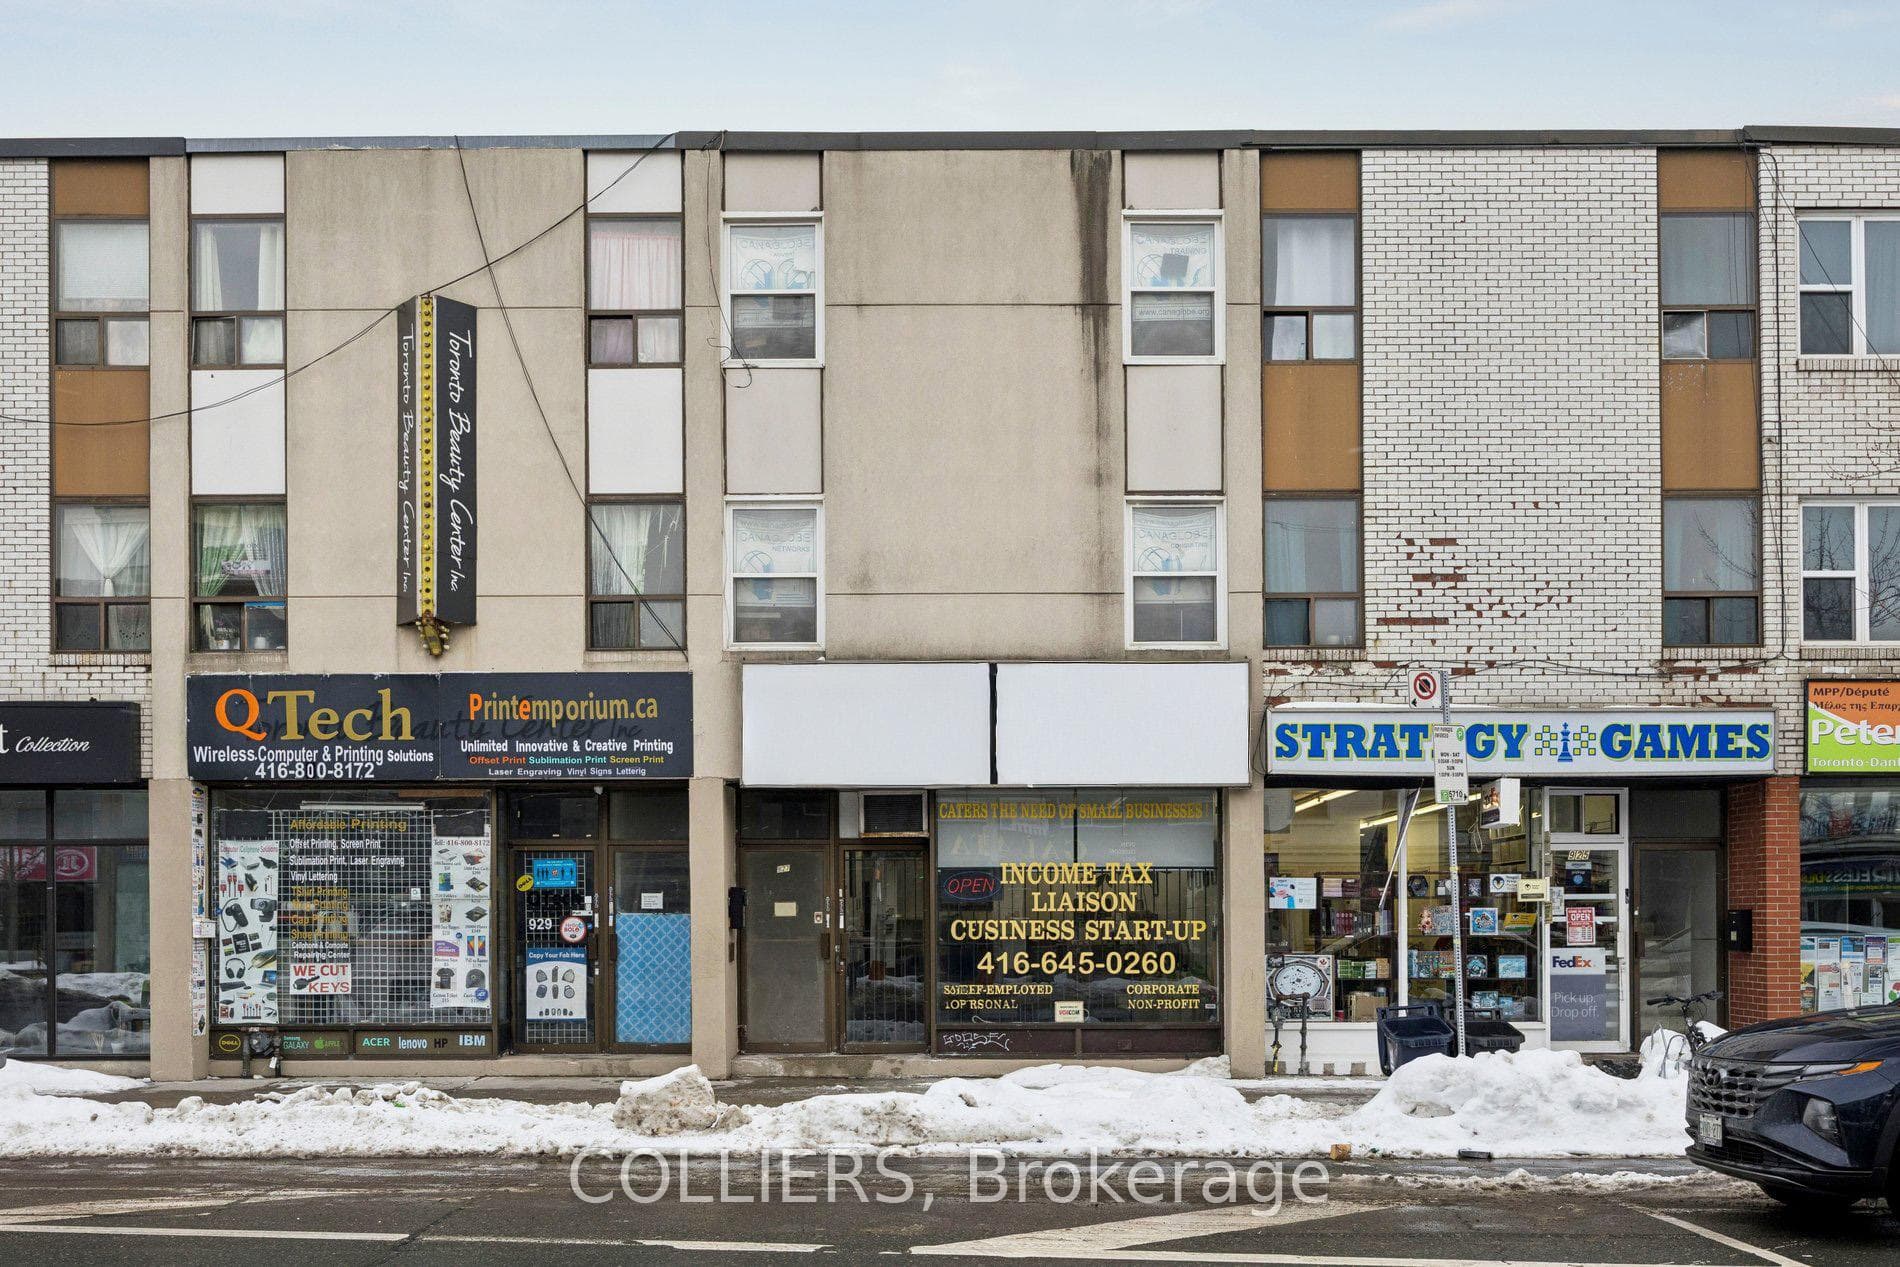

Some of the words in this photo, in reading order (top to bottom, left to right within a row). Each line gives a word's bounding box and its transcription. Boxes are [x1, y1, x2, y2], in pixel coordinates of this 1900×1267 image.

[402, 323, 415, 404] Toronto
[449, 330, 472, 404] Toronto
[399, 409, 414, 495] Beauty
[439, 408, 471, 493] Beauty
[403, 501, 415, 565] Center
[450, 499, 474, 570] Center
[1813, 687, 1890, 698] MPP/Député
[469, 691, 659, 728] Printemporium.ca
[16, 736, 90, 753] Collection
[461, 740, 508, 753] Unlimited
[516, 740, 568, 753] Innovative
[573, 740, 581, 752] &
[585, 739, 627, 752] Creative
[633, 739, 674, 754] Printing
[1275, 722, 1531, 760] STRATGY
[1599, 722, 1773, 760] GAMES
[322, 746, 332, 762] &
[335, 745, 384, 765] Printing
[387, 750, 434, 762] Solutions
[469, 756, 500, 765] Offset
[502, 756, 526, 765] Print
[529, 756, 582, 765] Sublimation
[585, 755, 606, 764] Print
[610, 755, 640, 764] Screen
[643, 755, 664, 764] Print
[255, 762, 375, 779] 416-800-8172
[488, 767, 513, 776] Laser
[517, 767, 562, 777] Engraving
[567, 767, 587, 777] Vinyl
[590, 767, 612, 777] Signs
[616, 767, 646, 777] Letterig
[1449, 790, 1463, 798] 5710
[939, 803, 988, 819] CATERS
[991, 803, 1016, 819] THE
[1021, 803, 1056, 819] NEED
[1058, 803, 1076, 819] OF
[1079, 803, 1122, 819] SMALL
[290, 819, 346, 830] Affordable
[351, 819, 407, 832] Printing
[289, 839, 310, 848] Offset
[340, 839, 365, 849] Screen
[366, 839, 381, 848] Print
[289, 856, 328, 865] Sublimation
[350, 856, 368, 865] Laser
[371, 856, 405, 867] Engraving
[1568, 850, 1591, 860] 925
[291, 873, 308, 883] Vinyl
[308, 873, 338, 883] Lettering
[1000, 863, 1096, 885] INCOME
[1106, 863, 1153, 885] TAX
[948, 877, 995, 894] OPEN
[1031, 892, 1137, 912] LIAISON
[1570, 913, 1591, 921] OPEN
[528, 918, 553, 931] 929
[1085, 919, 1207, 941] START-UP
[528, 952, 544, 960] Copy
[977, 951, 1176, 975] 416-645-0260
[1552, 956, 1592, 968] FedEx
[293, 965, 316, 977] WE
[320, 965, 348, 976] CUT
[308, 982, 350, 993] KEYS
[1126, 984, 1200, 995] CORPORATE
[1128, 999, 1200, 1009] NON-PROFIT
[1554, 991, 1577, 1003] Pick
[1580, 993, 1596, 1006] up.
[1551, 1006, 1579, 1020] Drop
[1581, 1005, 1600, 1017] off.
[283, 1041, 310, 1049] GALAXY
[362, 1038, 390, 1046] ACER
[398, 1036, 427, 1050] lenovo
[434, 1038, 448, 1049] HP
[458, 1035, 486, 1046] IBM
